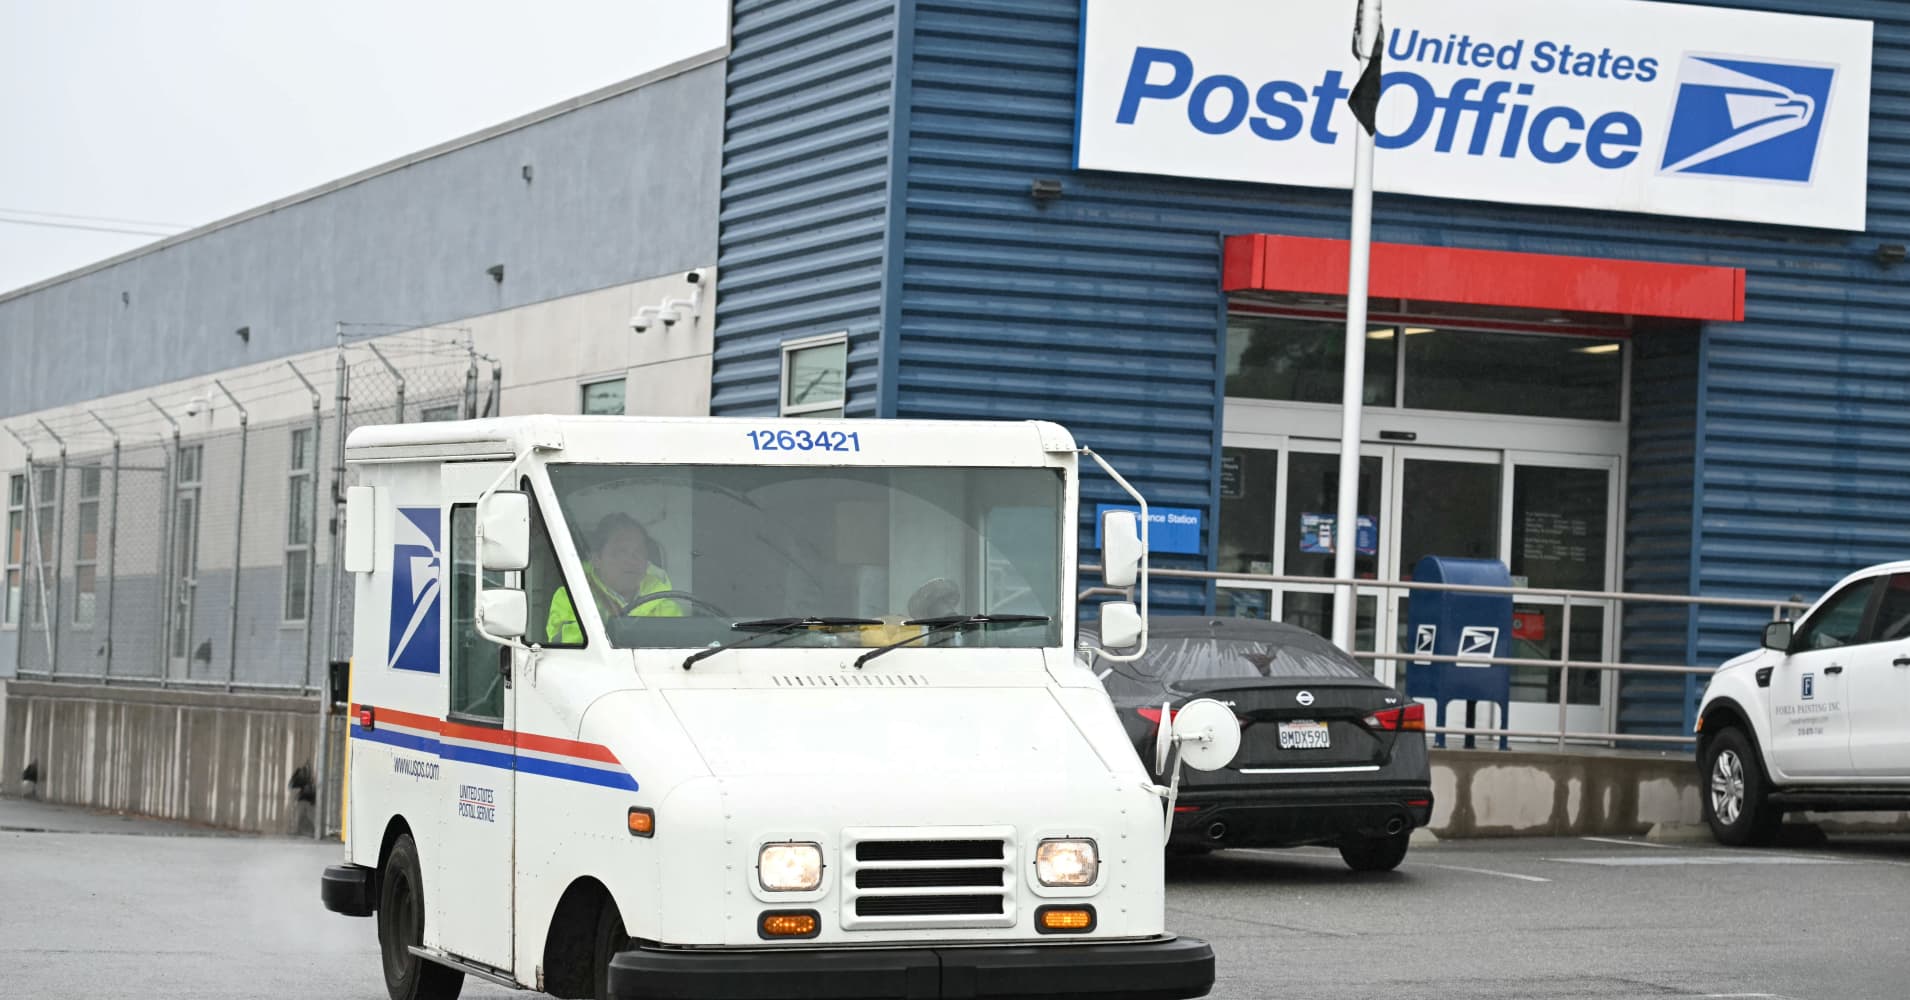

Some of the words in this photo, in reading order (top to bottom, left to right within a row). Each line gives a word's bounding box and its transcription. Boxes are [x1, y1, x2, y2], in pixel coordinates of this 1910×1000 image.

[1387, 28, 1524, 70] United
[1530, 41, 1659, 82] States
[1115, 46, 1350, 145] Post
[1373, 71, 1643, 169] Office
[746, 430, 860, 452] 1263421
[1168, 513, 1197, 524] Station
[1797, 703, 1827, 714] PAINTING
[1281, 730, 1328, 745] 8MDX590
[393, 757, 440, 782] www.usps.com
[459, 784, 477, 800] UNITED
[477, 787, 494, 803] STATES
[458, 801, 476, 818] POSTAL
[476, 805, 495, 822] SERVICE
